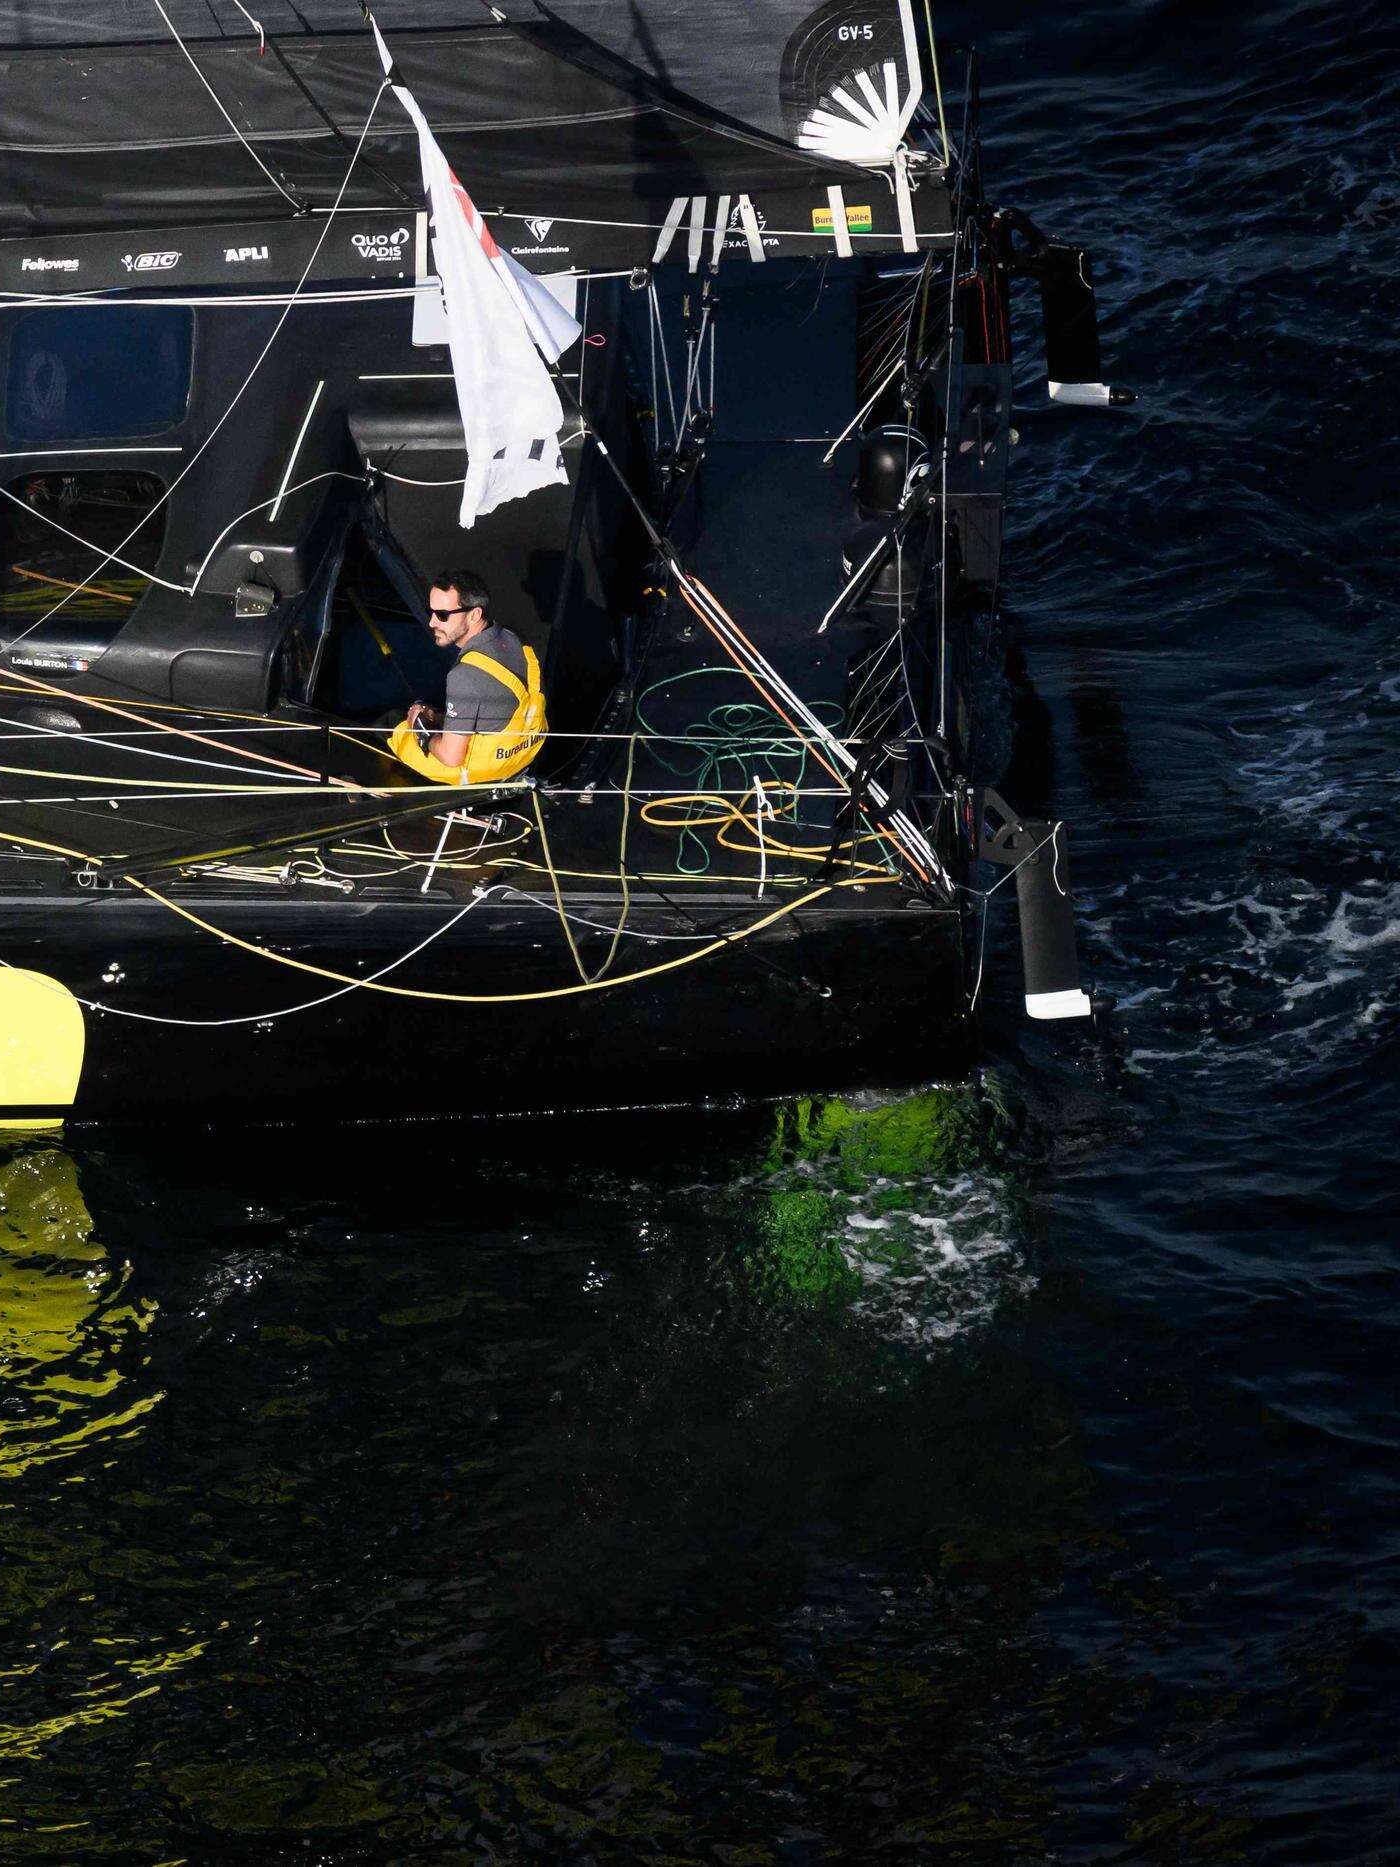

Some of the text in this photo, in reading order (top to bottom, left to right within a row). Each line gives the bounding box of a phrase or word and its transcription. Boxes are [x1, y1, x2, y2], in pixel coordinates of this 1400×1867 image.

[839, 24, 873, 41] GV-5
[351, 233, 389, 247] QUO
[722, 238, 780, 249] EXACPTA
[225, 246, 269, 262] APLI
[358, 246, 402, 258] VADIS
[511, 245, 570, 255] Clairefontaine
[21, 257, 80, 271] Fellowes
[11, 656, 68, 669] Louis BURTON
